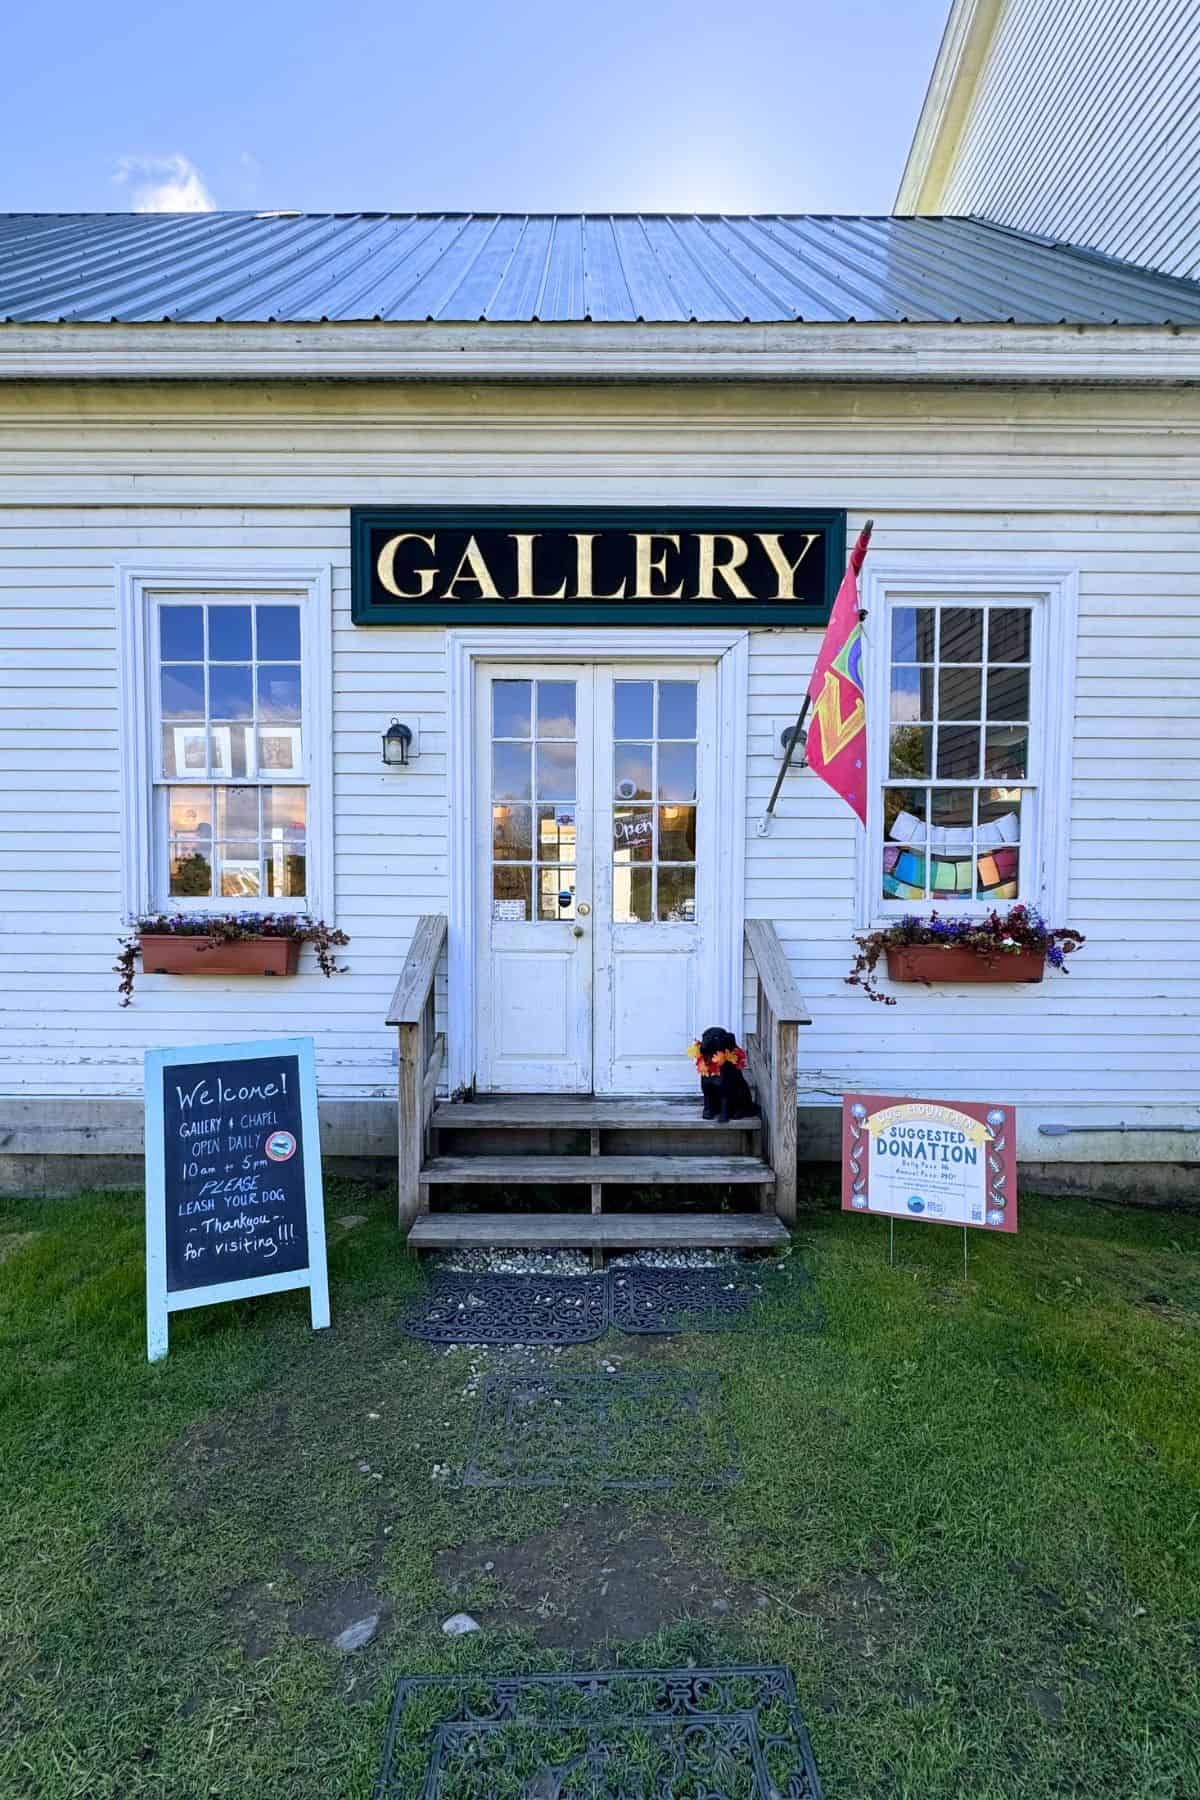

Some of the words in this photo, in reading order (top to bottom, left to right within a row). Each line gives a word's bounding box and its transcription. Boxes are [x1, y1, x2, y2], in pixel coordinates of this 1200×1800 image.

[376, 532, 821, 600] GALLERY
[614, 820, 653, 841] Open
[176, 1073, 287, 1110] Welcome!
[180, 1118, 221, 1138] GALLERY
[241, 1112, 277, 1128] CHAPEL
[889, 1126, 966, 1145] SUGGESTED
[192, 1137, 220, 1157] OPEN
[228, 1134, 261, 1153] DAILY
[877, 1138, 978, 1165] DONATION
[199, 1174, 261, 1196] PLEASE
[178, 1198, 215, 1216] LEASH
[224, 1192, 259, 1208] YOUR
[262, 1188, 286, 1203] DOG
[183, 1242, 205, 1261] for
